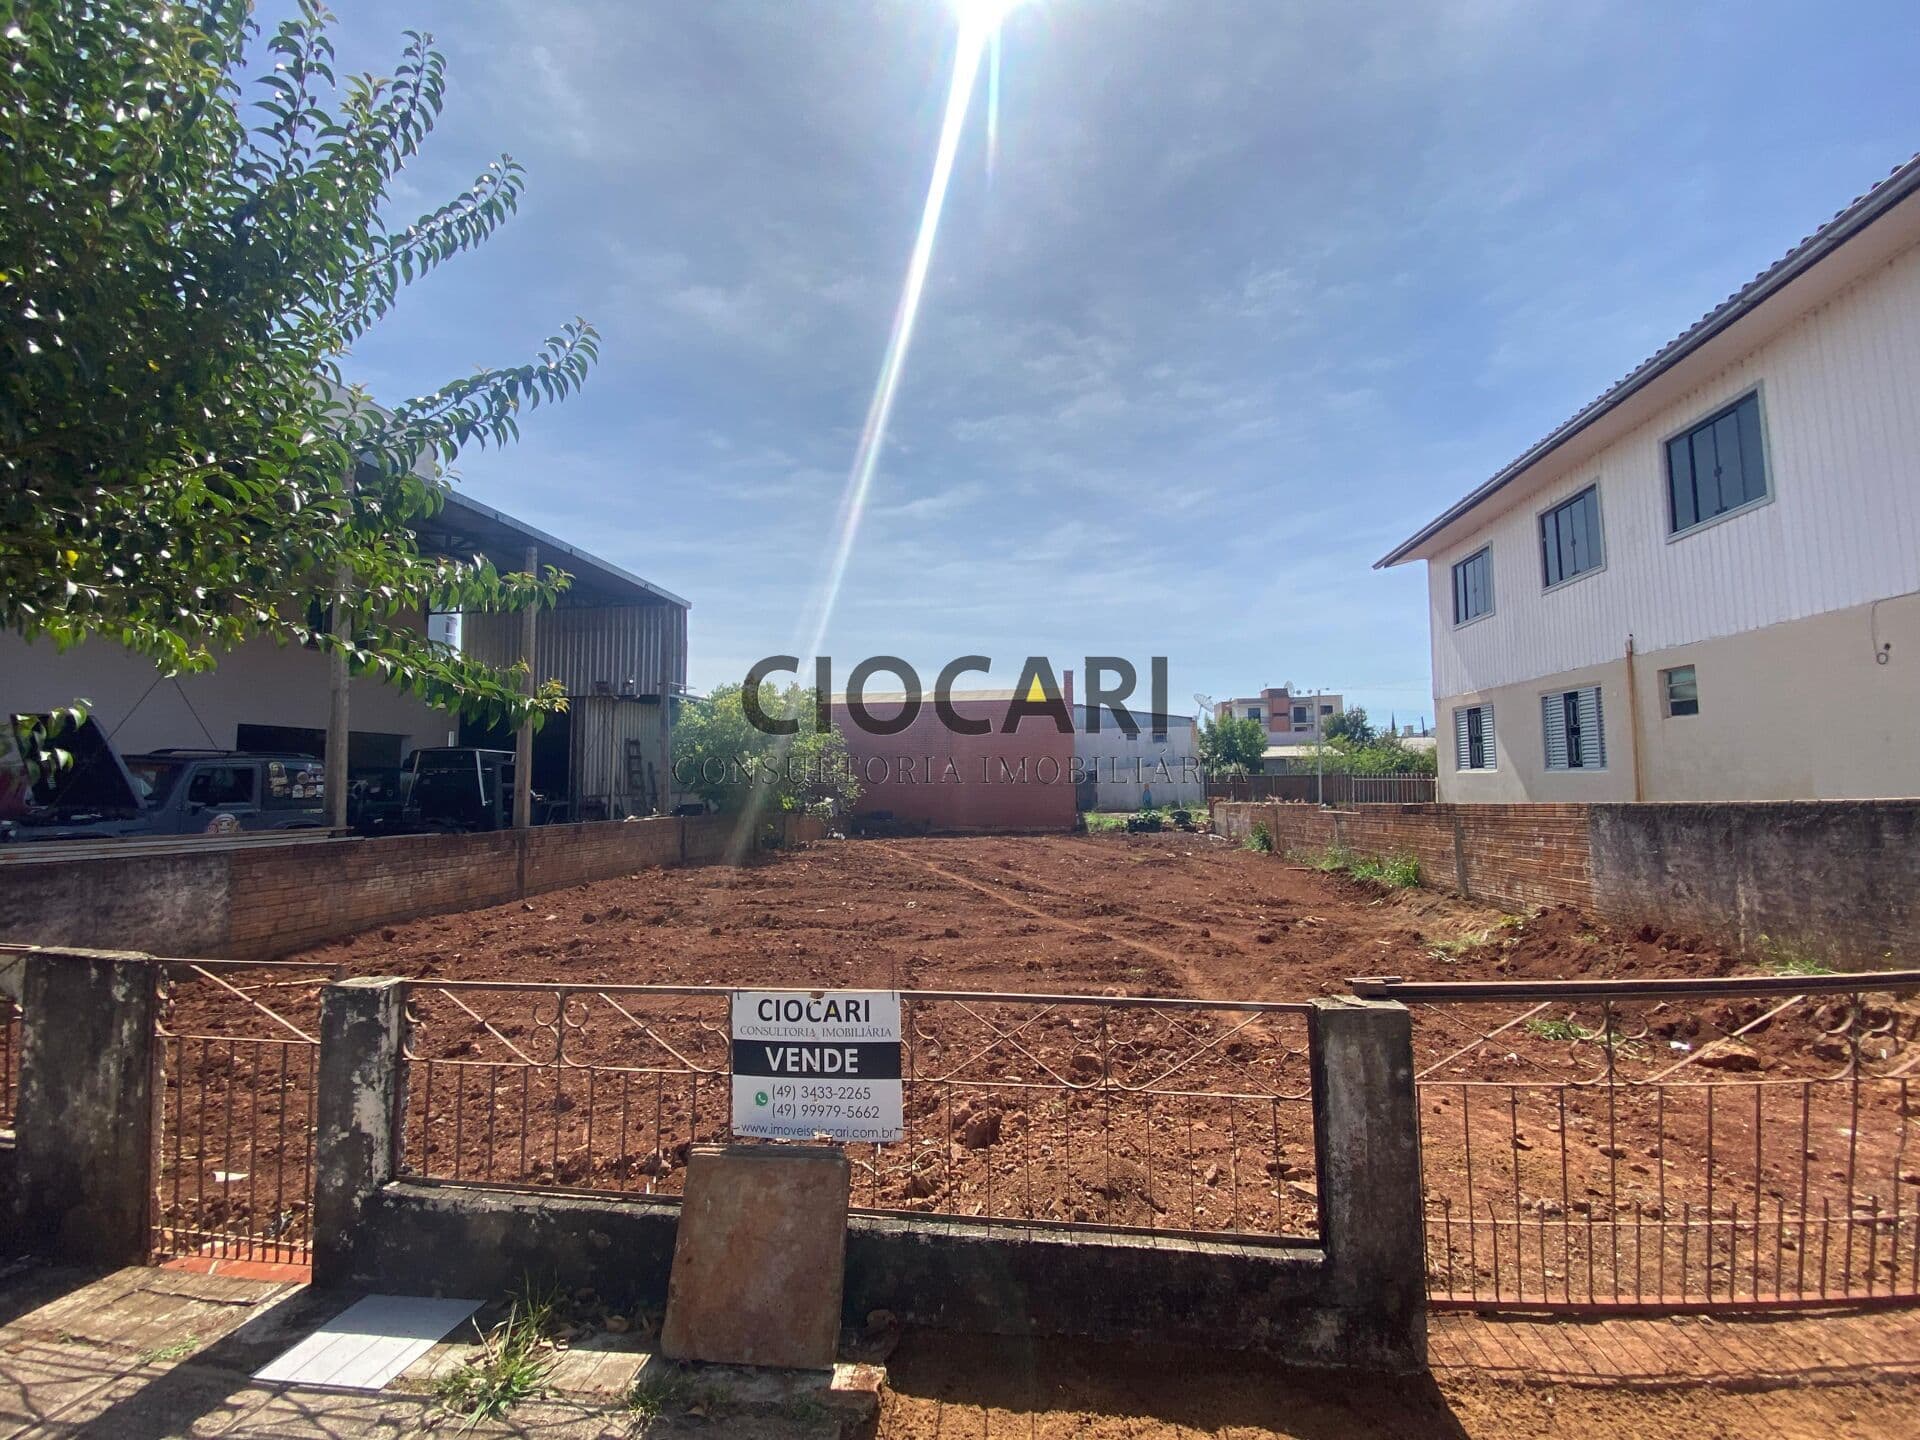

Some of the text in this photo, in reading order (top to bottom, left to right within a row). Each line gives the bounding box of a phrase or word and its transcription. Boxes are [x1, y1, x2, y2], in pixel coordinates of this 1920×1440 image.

[758, 999, 870, 1022] CIOCARI
[740, 1025, 892, 1038] CONSULTORIA IMOBILIÁRIA
[765, 1046, 859, 1073] VENDE
[772, 1085, 871, 1101] (49) 3433-2265
[772, 1104, 880, 1119] (49) 99979-5662
